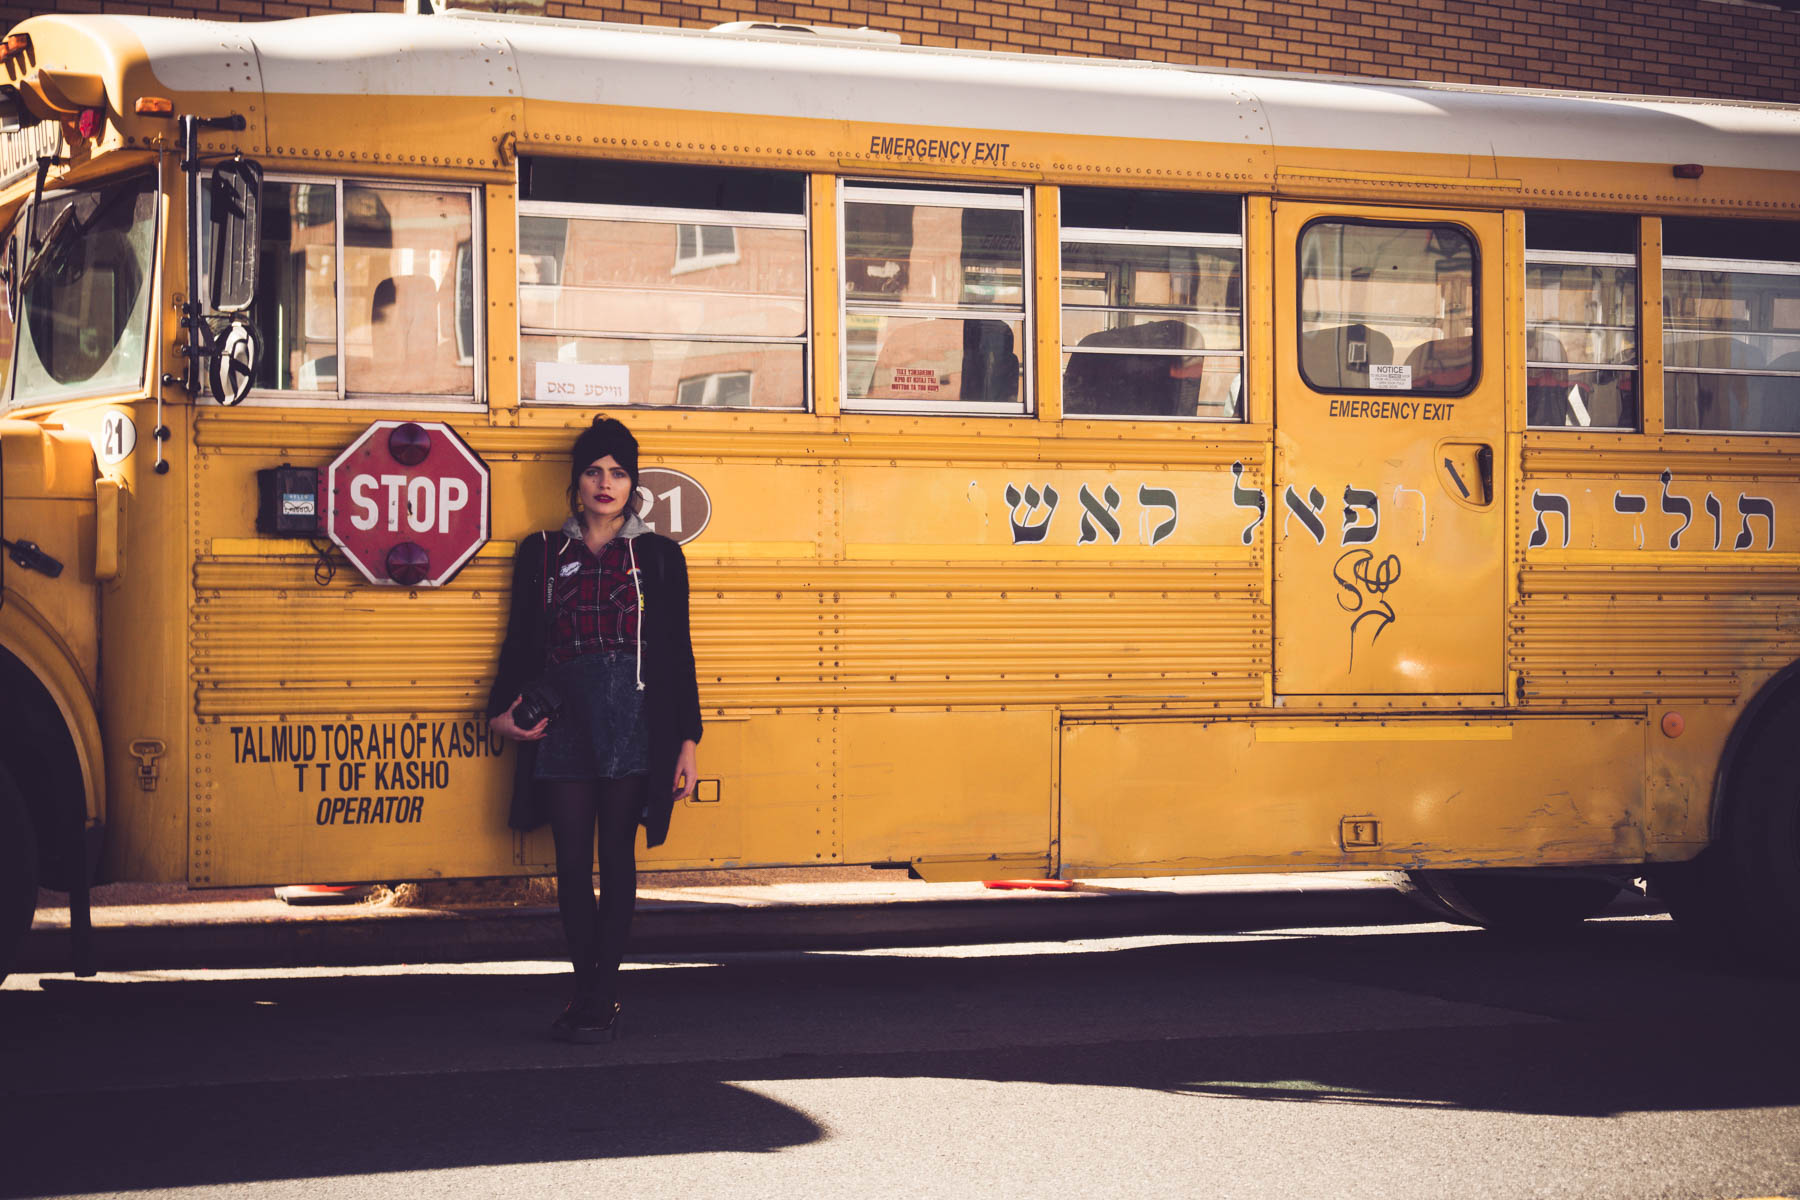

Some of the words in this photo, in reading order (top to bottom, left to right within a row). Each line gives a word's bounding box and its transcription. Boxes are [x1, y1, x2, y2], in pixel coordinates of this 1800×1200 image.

[870, 136, 972, 159] EMERGENCY
[975, 142, 1010, 161] EXIT
[1377, 366, 1404, 374] NOTICE
[1329, 400, 1420, 419] EMERGENCY
[1423, 403, 1455, 420] EXIT
[105, 418, 123, 455] 21
[350, 474, 469, 533] STOP
[636, 485, 683, 533] 21
[230, 725, 316, 763] TALMUD
[321, 723, 396, 761] TORAH
[400, 722, 428, 759] OF
[432, 721, 505, 758] KASHO
[294, 763, 308, 792] T
[316, 763, 331, 792] T
[339, 762, 366, 791] OF
[375, 760, 449, 790] KASHO
[316, 796, 424, 825] OPERATOR
